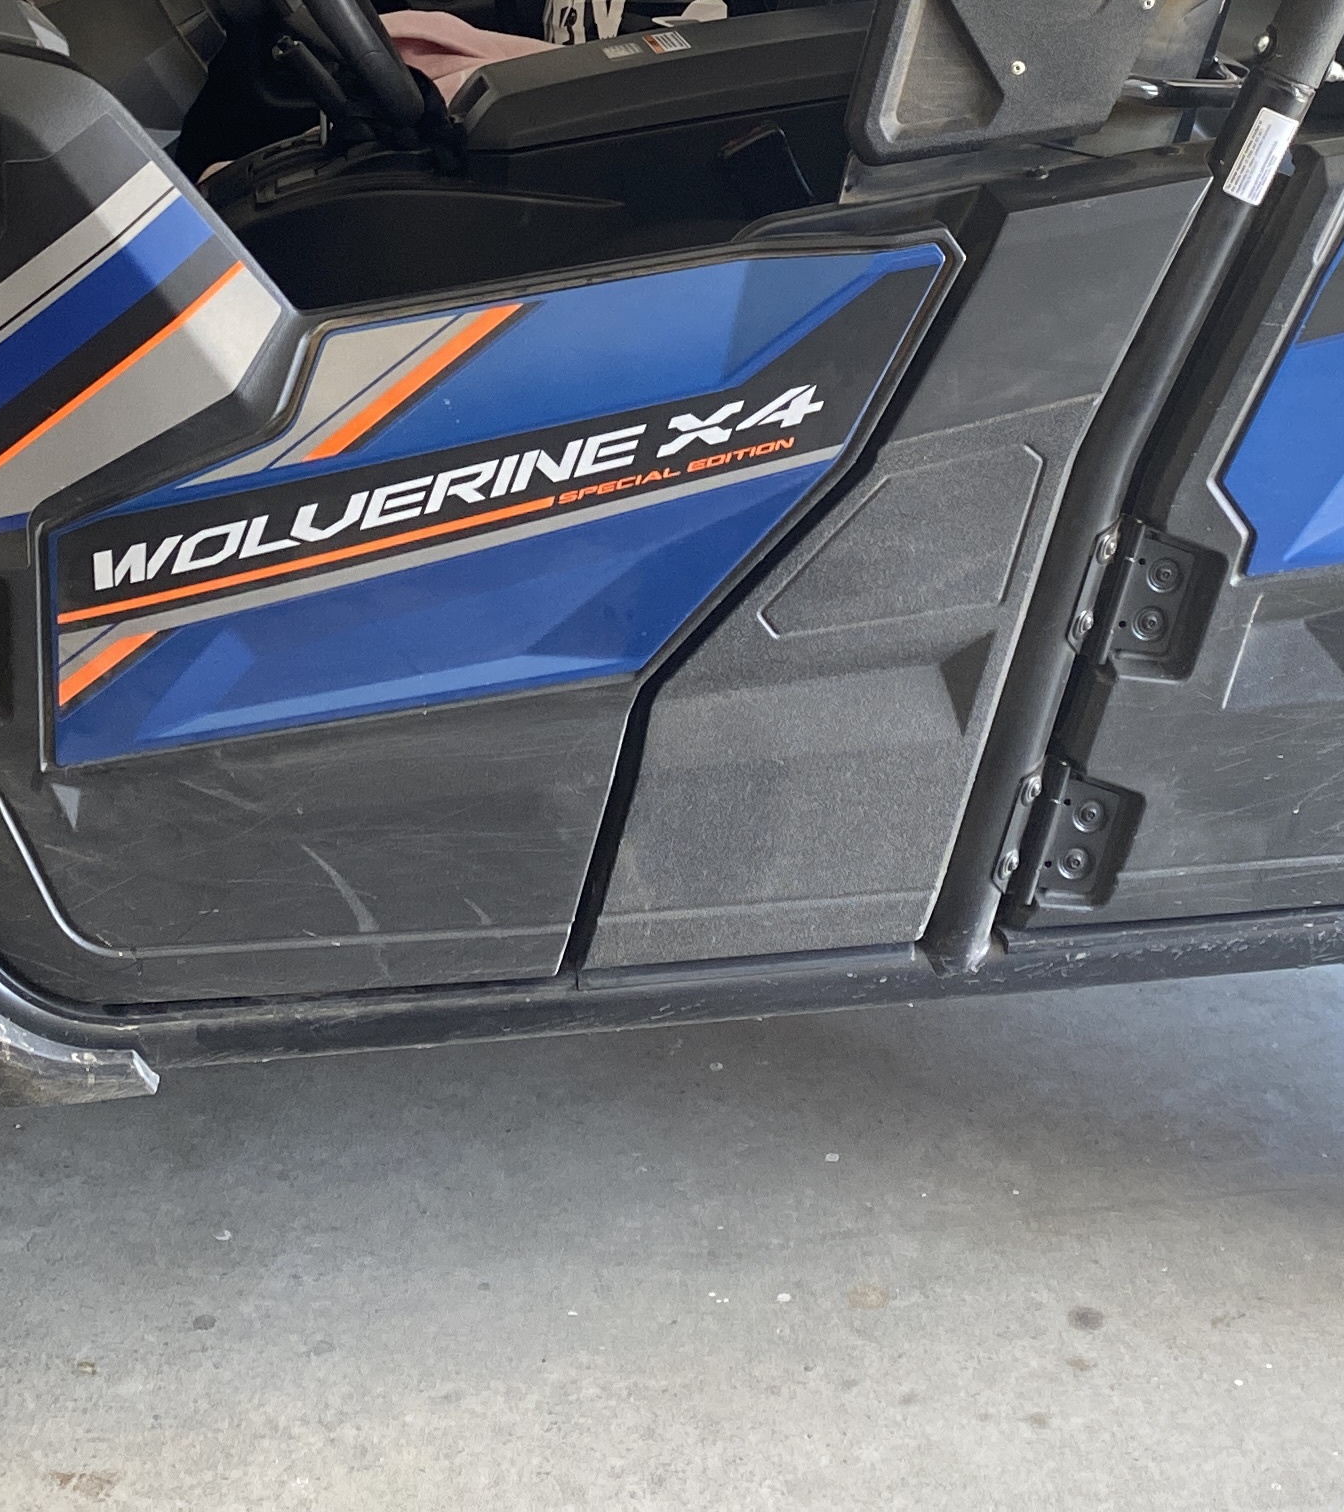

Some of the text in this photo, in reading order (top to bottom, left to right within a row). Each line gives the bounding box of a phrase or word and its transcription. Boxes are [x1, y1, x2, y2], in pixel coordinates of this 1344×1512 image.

[92, 384, 825, 592] WOLVERINE X4
[558, 436, 795, 505] SPECIAL EDITION
